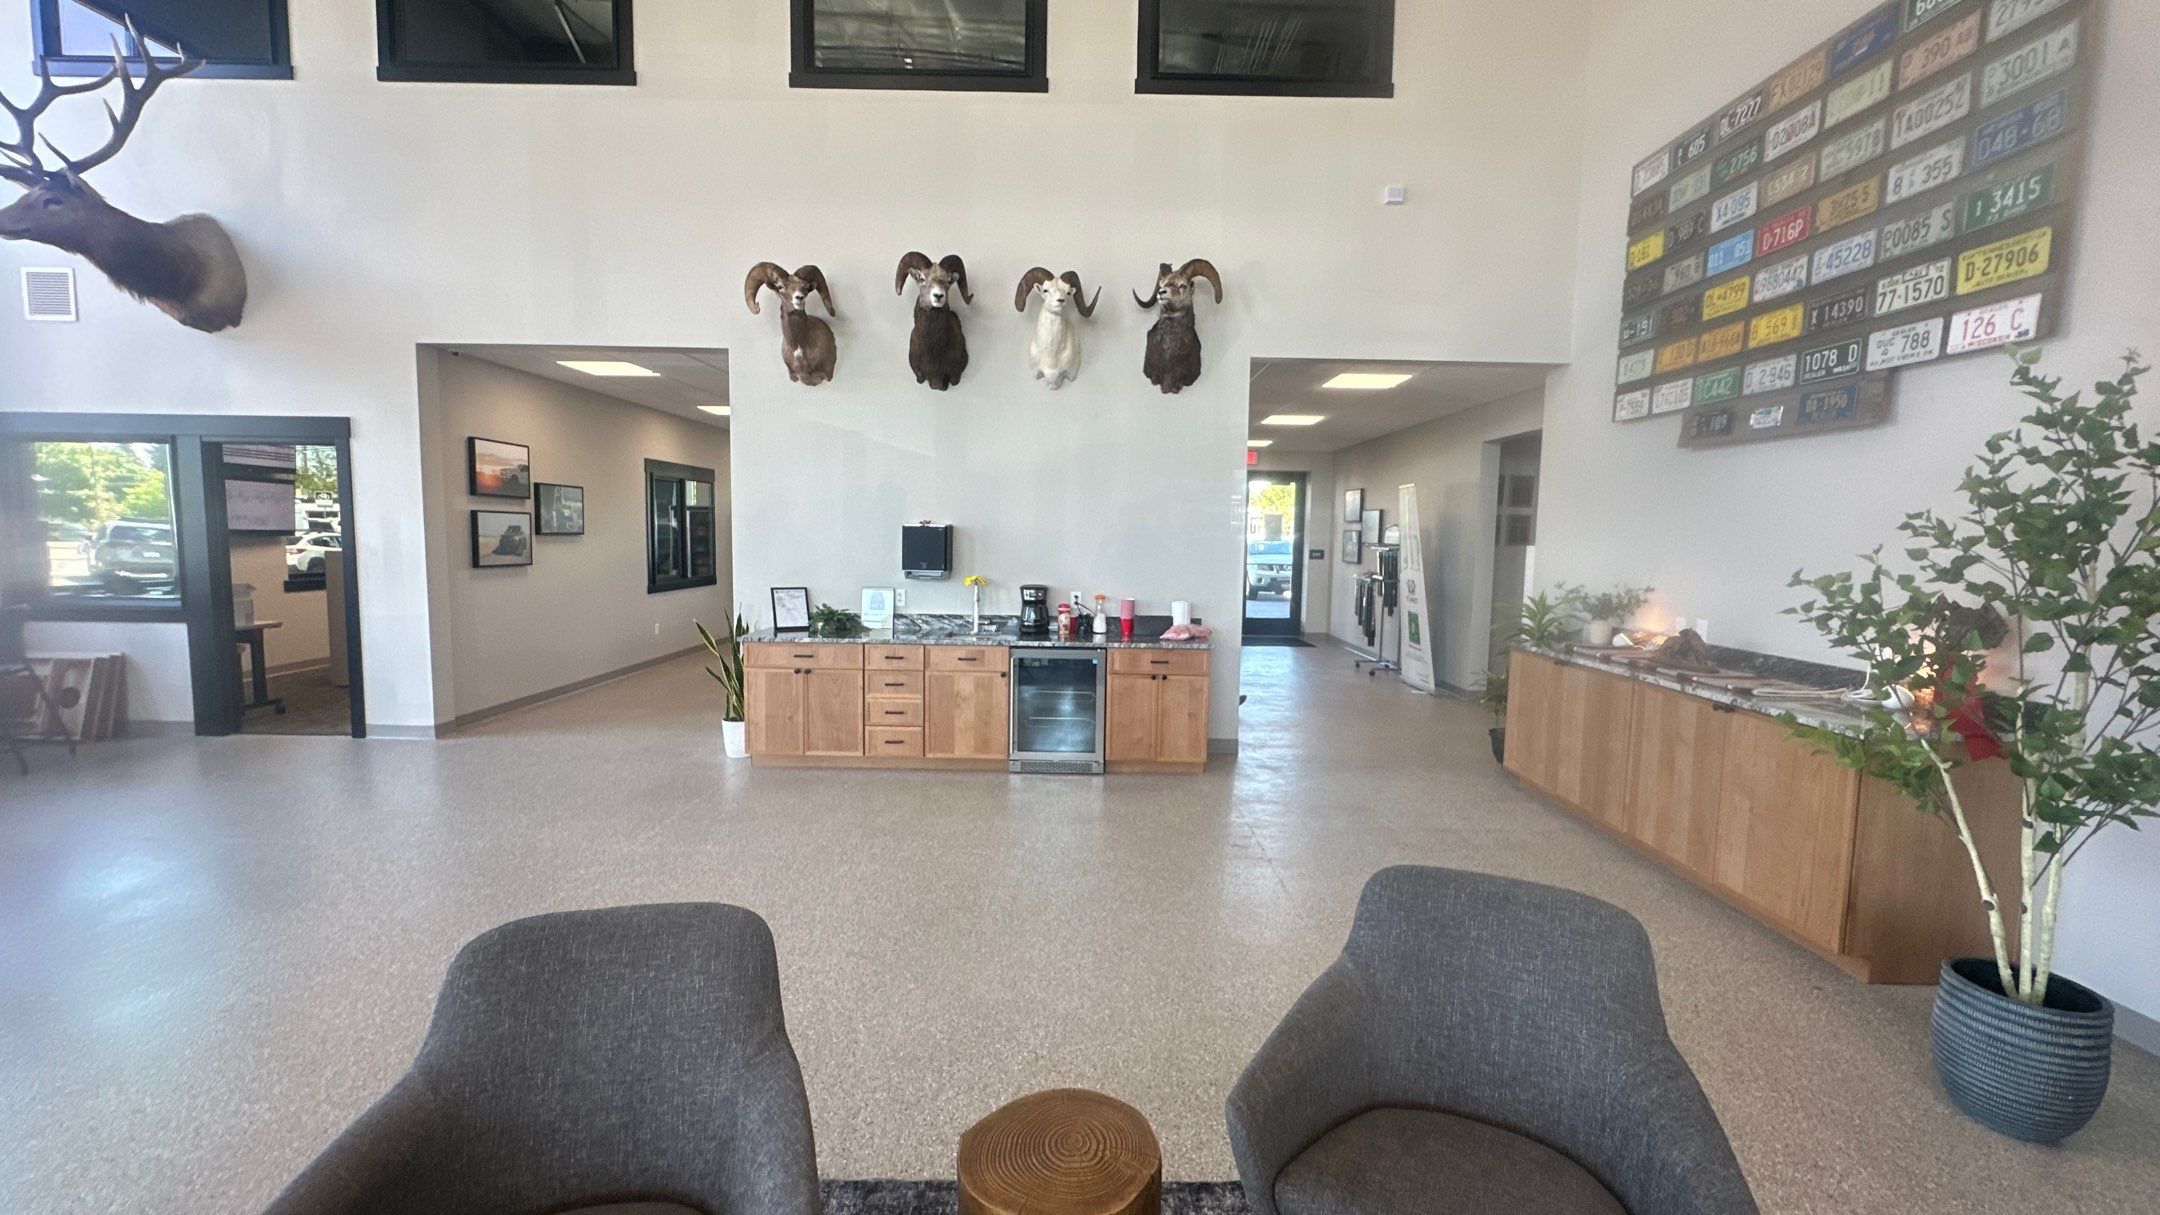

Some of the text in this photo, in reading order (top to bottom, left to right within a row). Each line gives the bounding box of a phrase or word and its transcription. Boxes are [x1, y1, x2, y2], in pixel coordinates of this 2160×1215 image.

[1998, 40, 2048, 86] 3001
[1921, 154, 1953, 186] 355
[1990, 174, 2042, 213] 3415
[1891, 215, 1931, 249] 0085
[1964, 241, 2040, 282] D-27906
[1823, 295, 1863, 321] 14390
[1961, 306, 2025, 341] 126 C
[1899, 329, 1930, 352] 788
[1805, 347, 1838, 372] 1078
